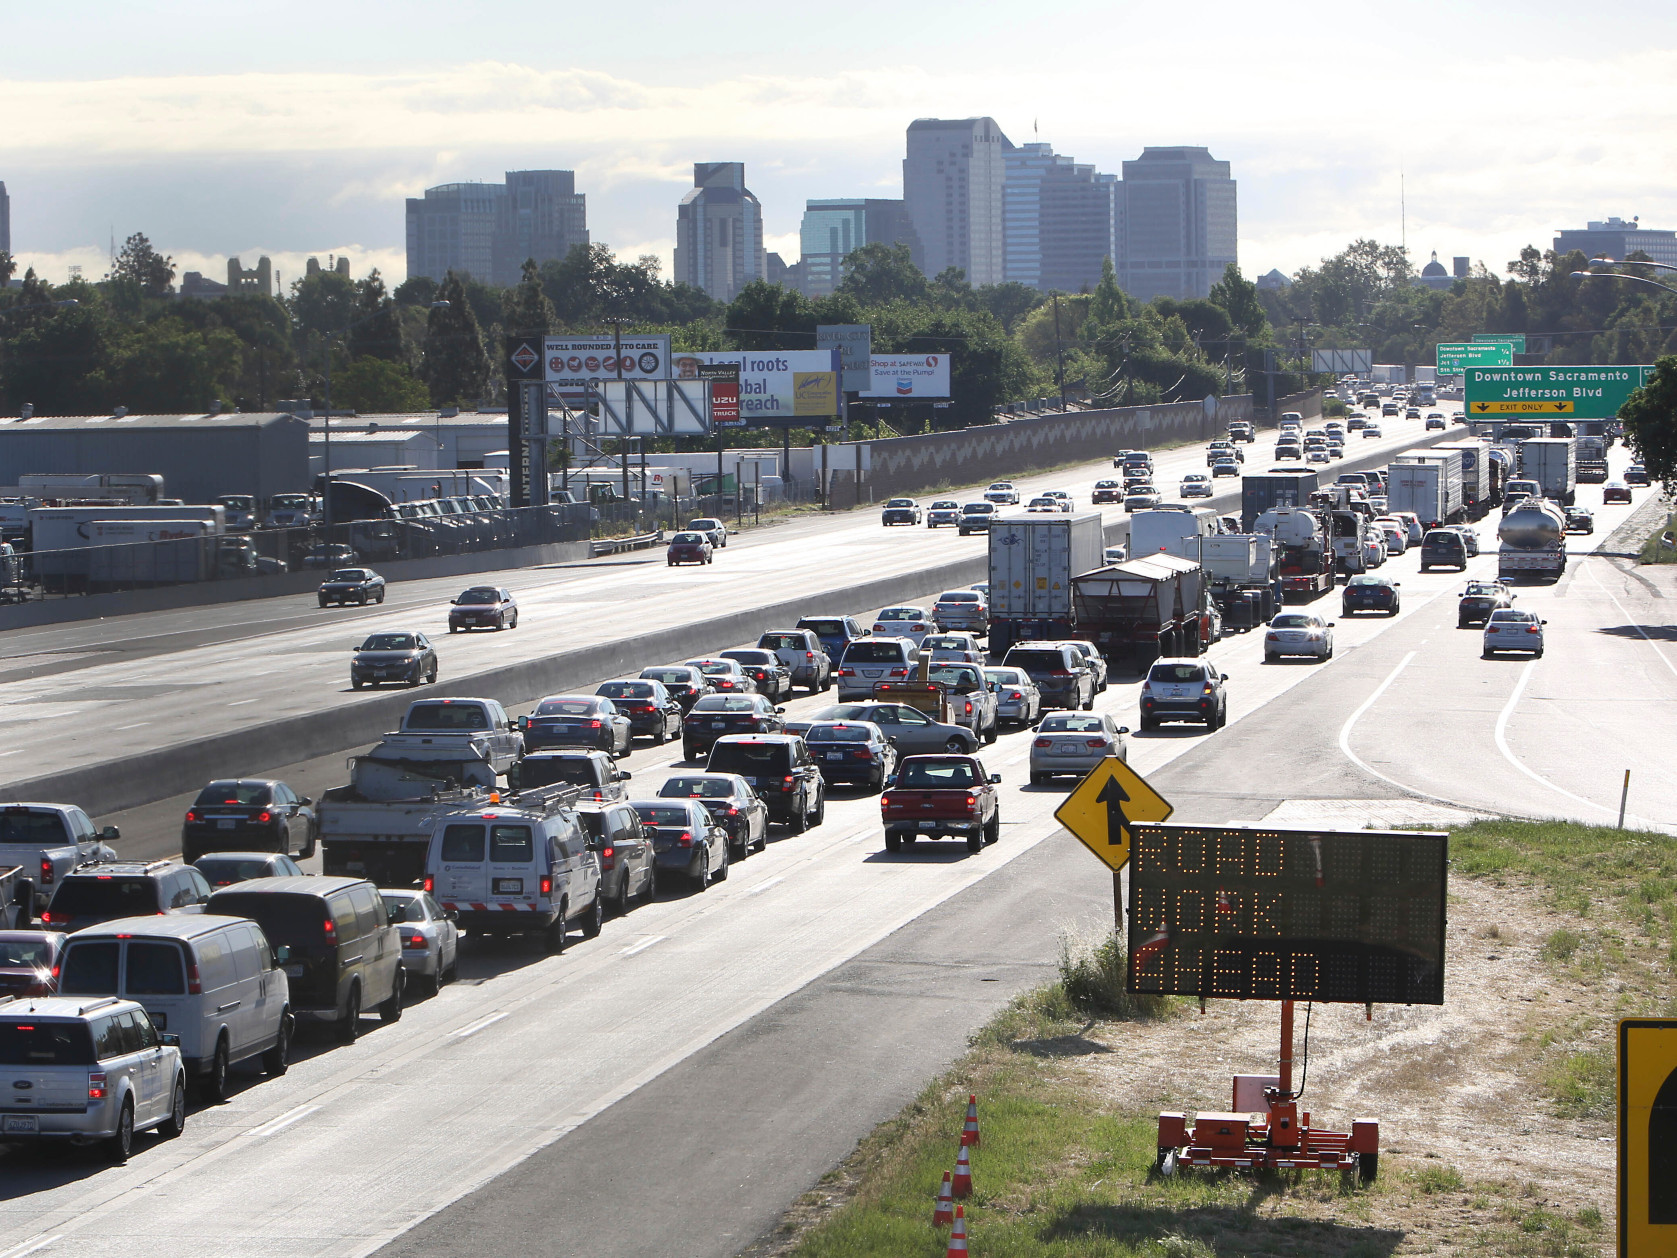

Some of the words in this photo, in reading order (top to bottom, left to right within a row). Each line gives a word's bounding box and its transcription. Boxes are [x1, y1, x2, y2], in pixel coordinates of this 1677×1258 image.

[571, 343, 612, 351] ROUNDED
[751, 358, 788, 372] roots
[870, 360, 889, 368] Shop
[912, 369, 935, 377] Pump!
[1475, 371, 1542, 381] Downtown
[1549, 371, 1629, 381] Sacramento
[1503, 387, 1566, 398] Jefferson
[1573, 387, 1602, 397] Blvd
[740, 394, 780, 411] reach
[1139, 829, 1284, 876] ROAD
[1137, 888, 1283, 936] WORK
[1135, 947, 1319, 996] AHEAD
